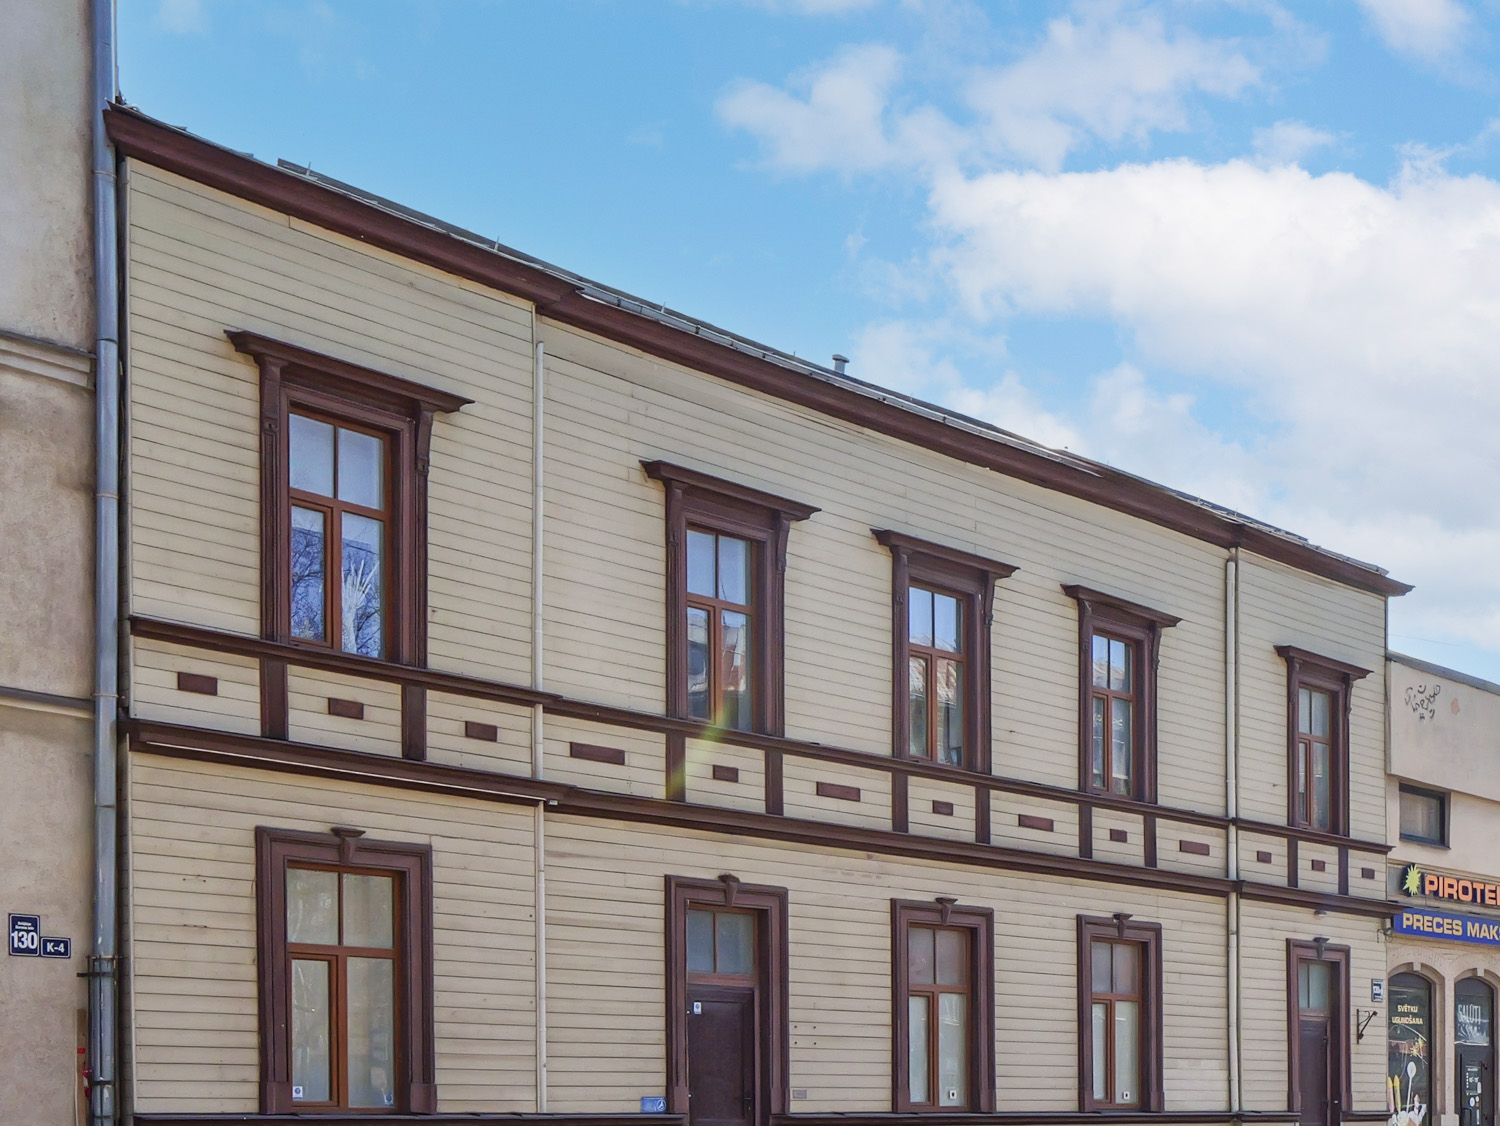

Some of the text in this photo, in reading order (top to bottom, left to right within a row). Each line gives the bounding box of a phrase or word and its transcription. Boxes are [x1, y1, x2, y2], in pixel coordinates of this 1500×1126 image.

[1402, 912, 1463, 936] PRECES
[10, 931, 38, 949] 130
[46, 942, 65, 953] K-4
